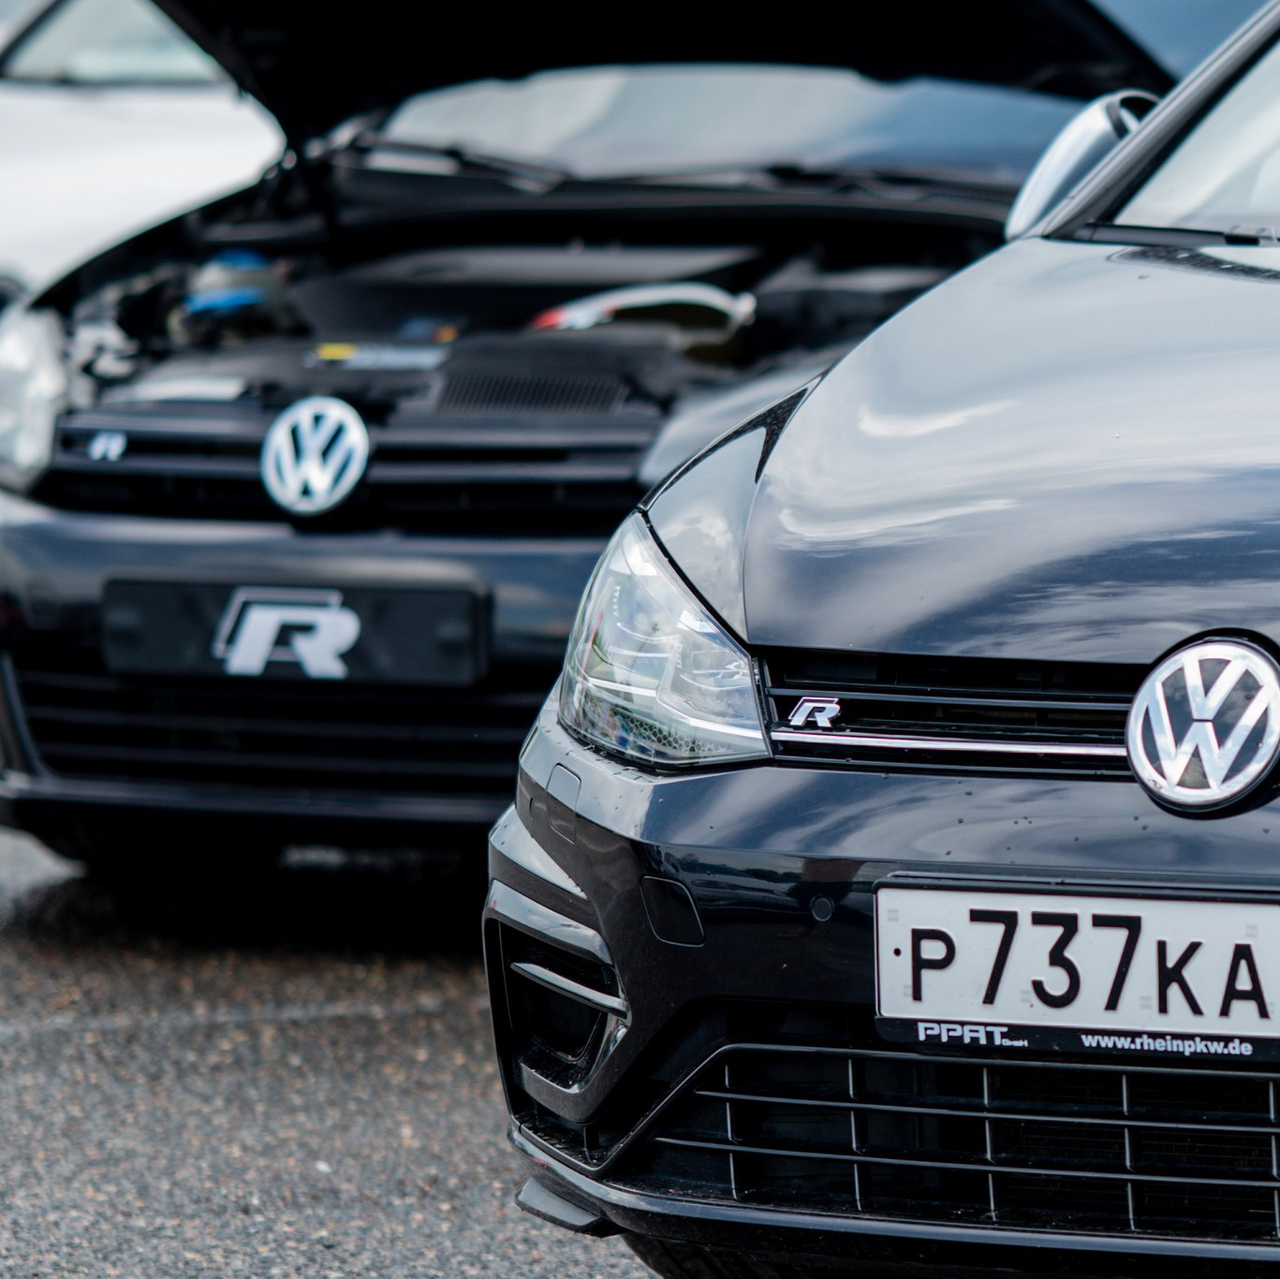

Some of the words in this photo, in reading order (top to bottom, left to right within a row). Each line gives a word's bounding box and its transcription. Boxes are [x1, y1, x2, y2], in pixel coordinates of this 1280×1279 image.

[213, 586, 361, 679] R
[788, 696, 842, 728] R
[917, 1021, 1009, 1046] PPAT
[1080, 1034, 1253, 1056] www.rheinpkw.de
